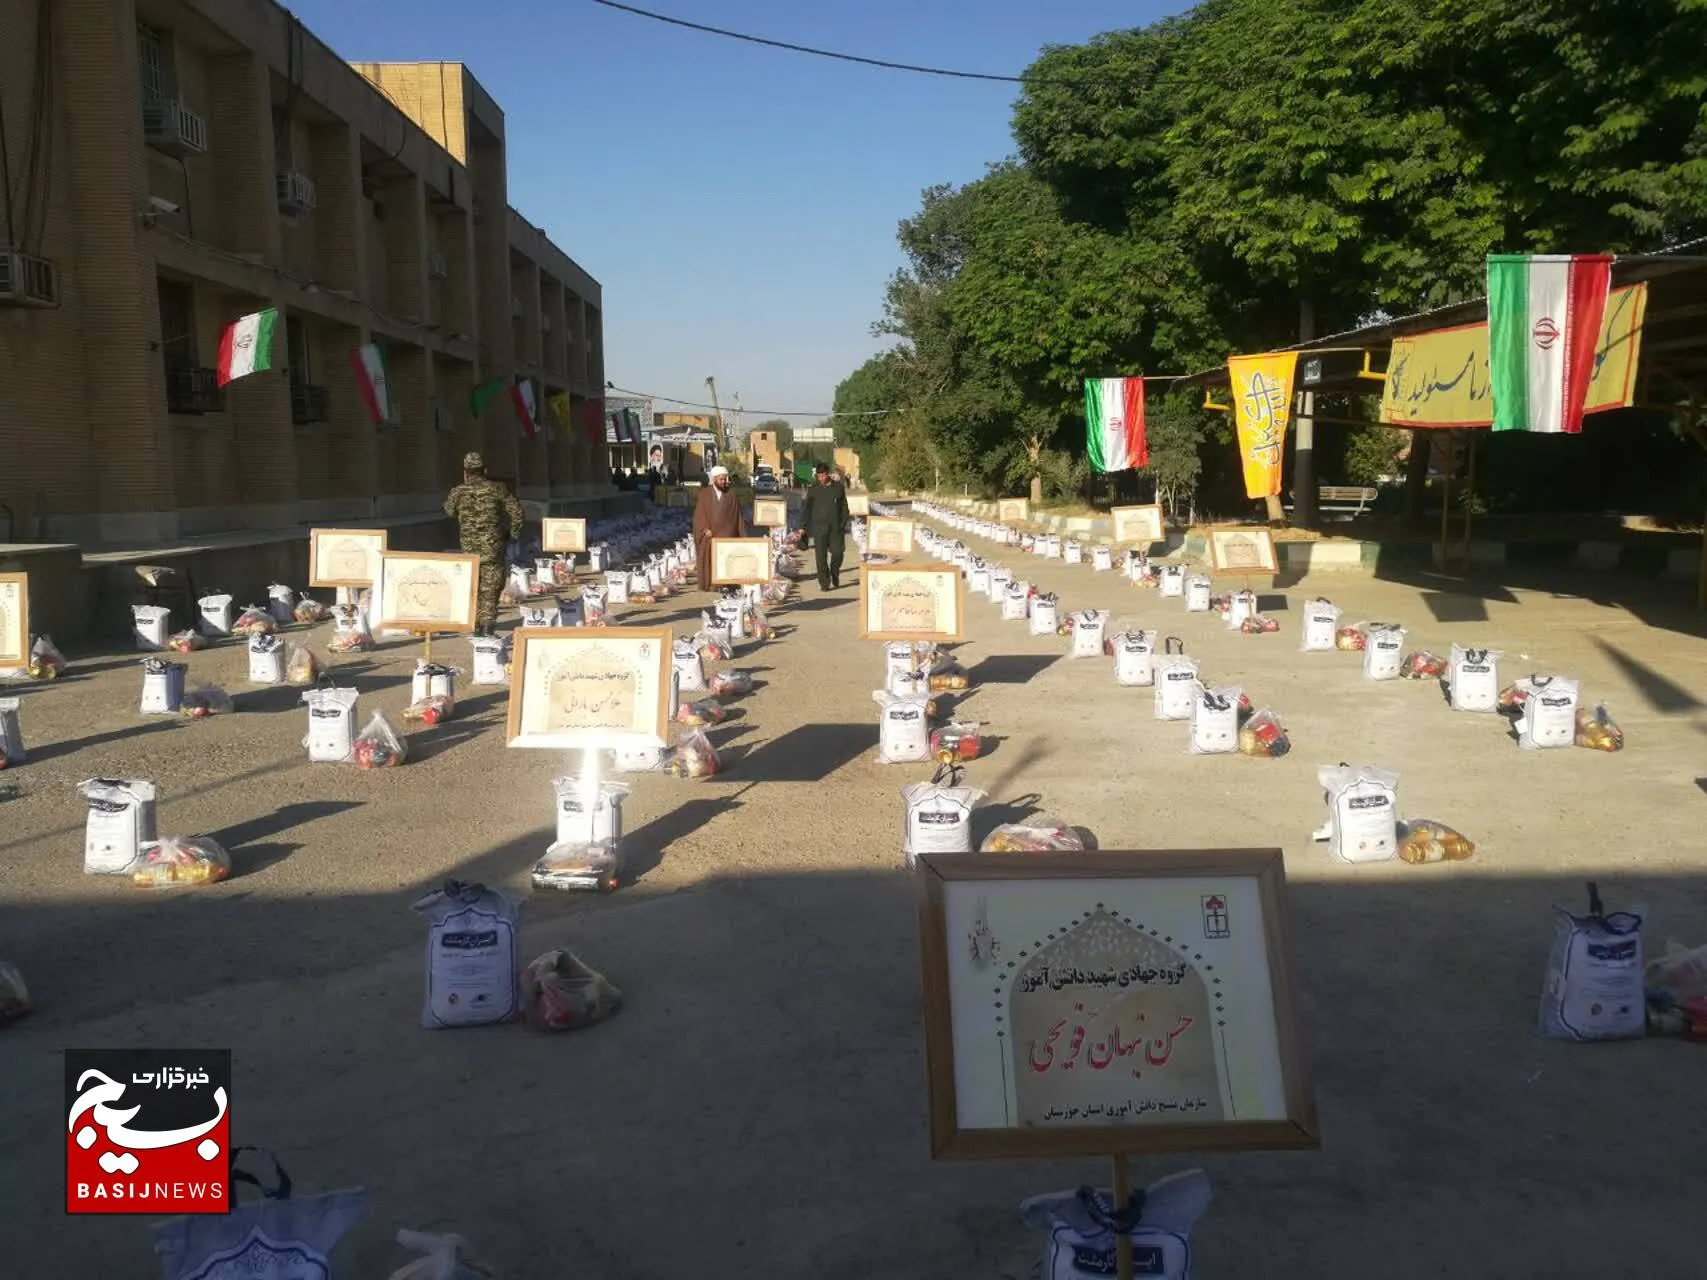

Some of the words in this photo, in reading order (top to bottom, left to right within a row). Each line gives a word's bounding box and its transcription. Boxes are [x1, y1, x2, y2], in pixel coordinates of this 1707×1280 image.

[1021, 967, 1049, 993] آموز
[1051, 967, 1085, 990] دانش
[1087, 966, 1117, 988] شهید
[1118, 964, 1158, 988] جهادی
[1159, 963, 1187, 985] گروه
